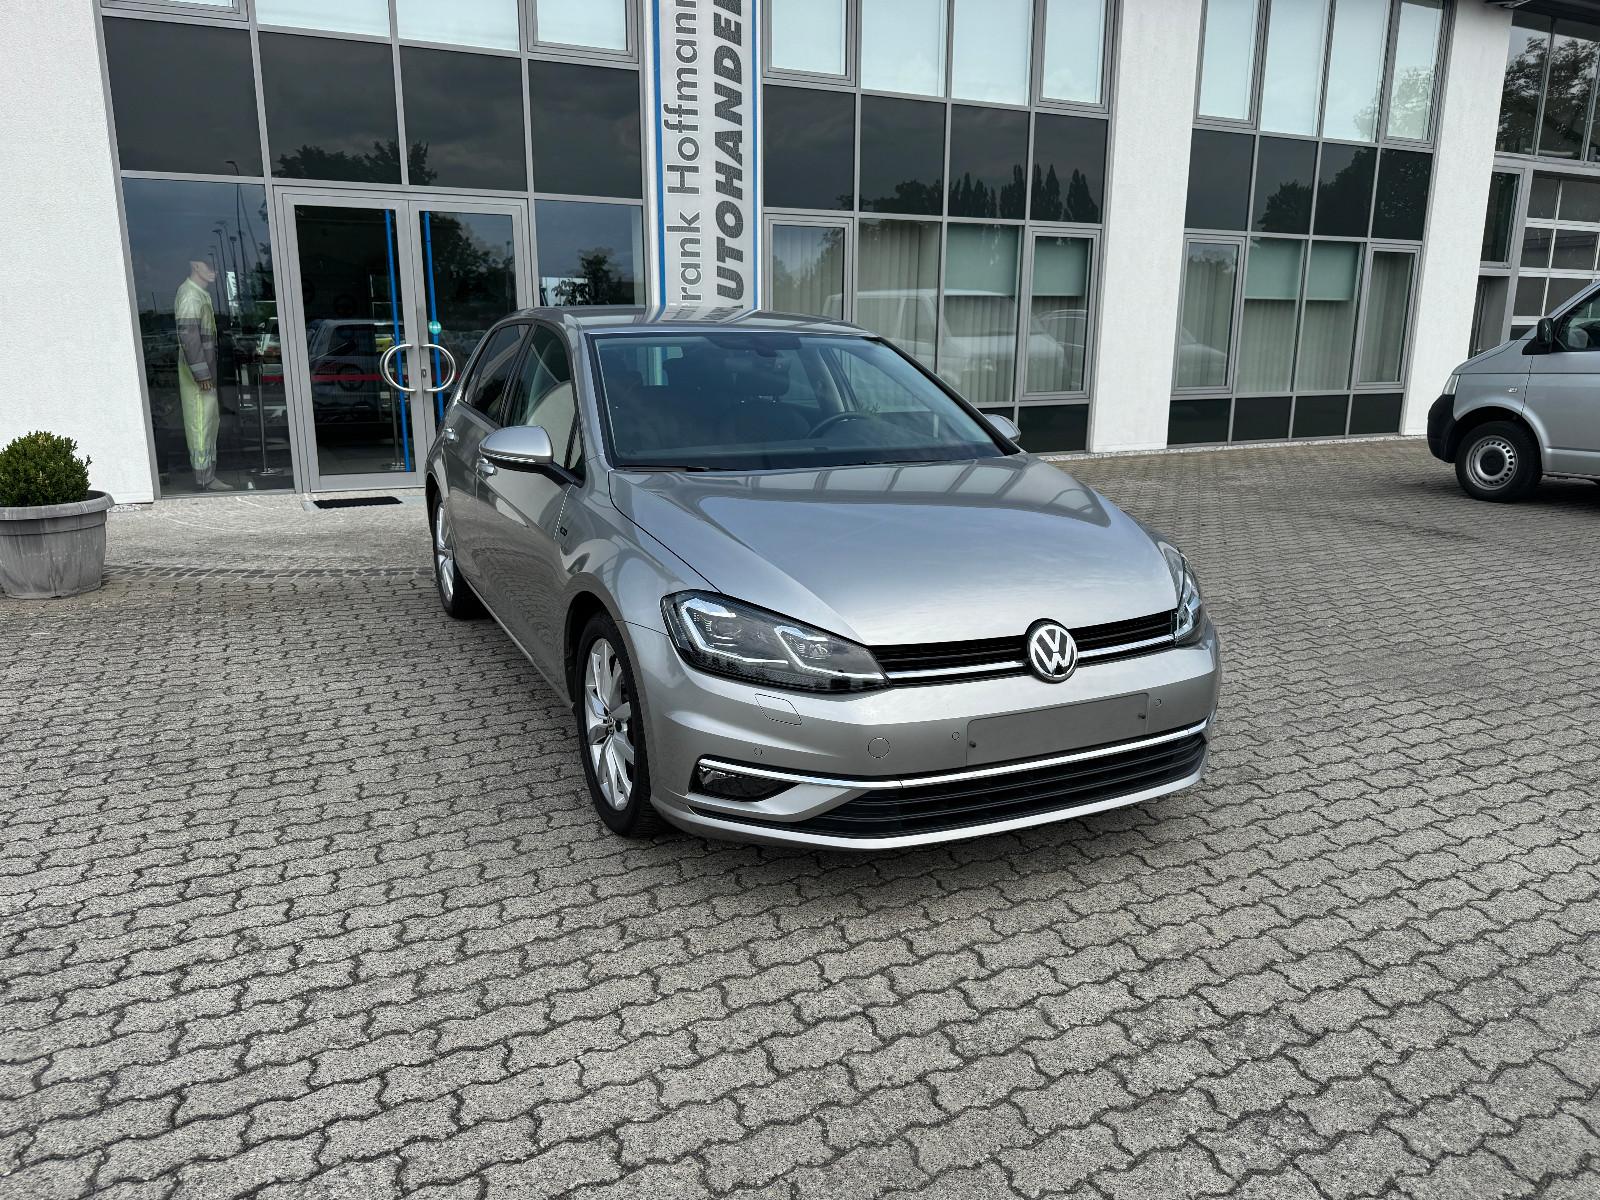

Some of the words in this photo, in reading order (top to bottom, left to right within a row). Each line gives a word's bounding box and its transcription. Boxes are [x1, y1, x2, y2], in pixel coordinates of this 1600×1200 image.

[713, 0, 744, 308] UTOHANDE
[666, 211, 703, 305] rank
[1029, 623, 1078, 678] VW
